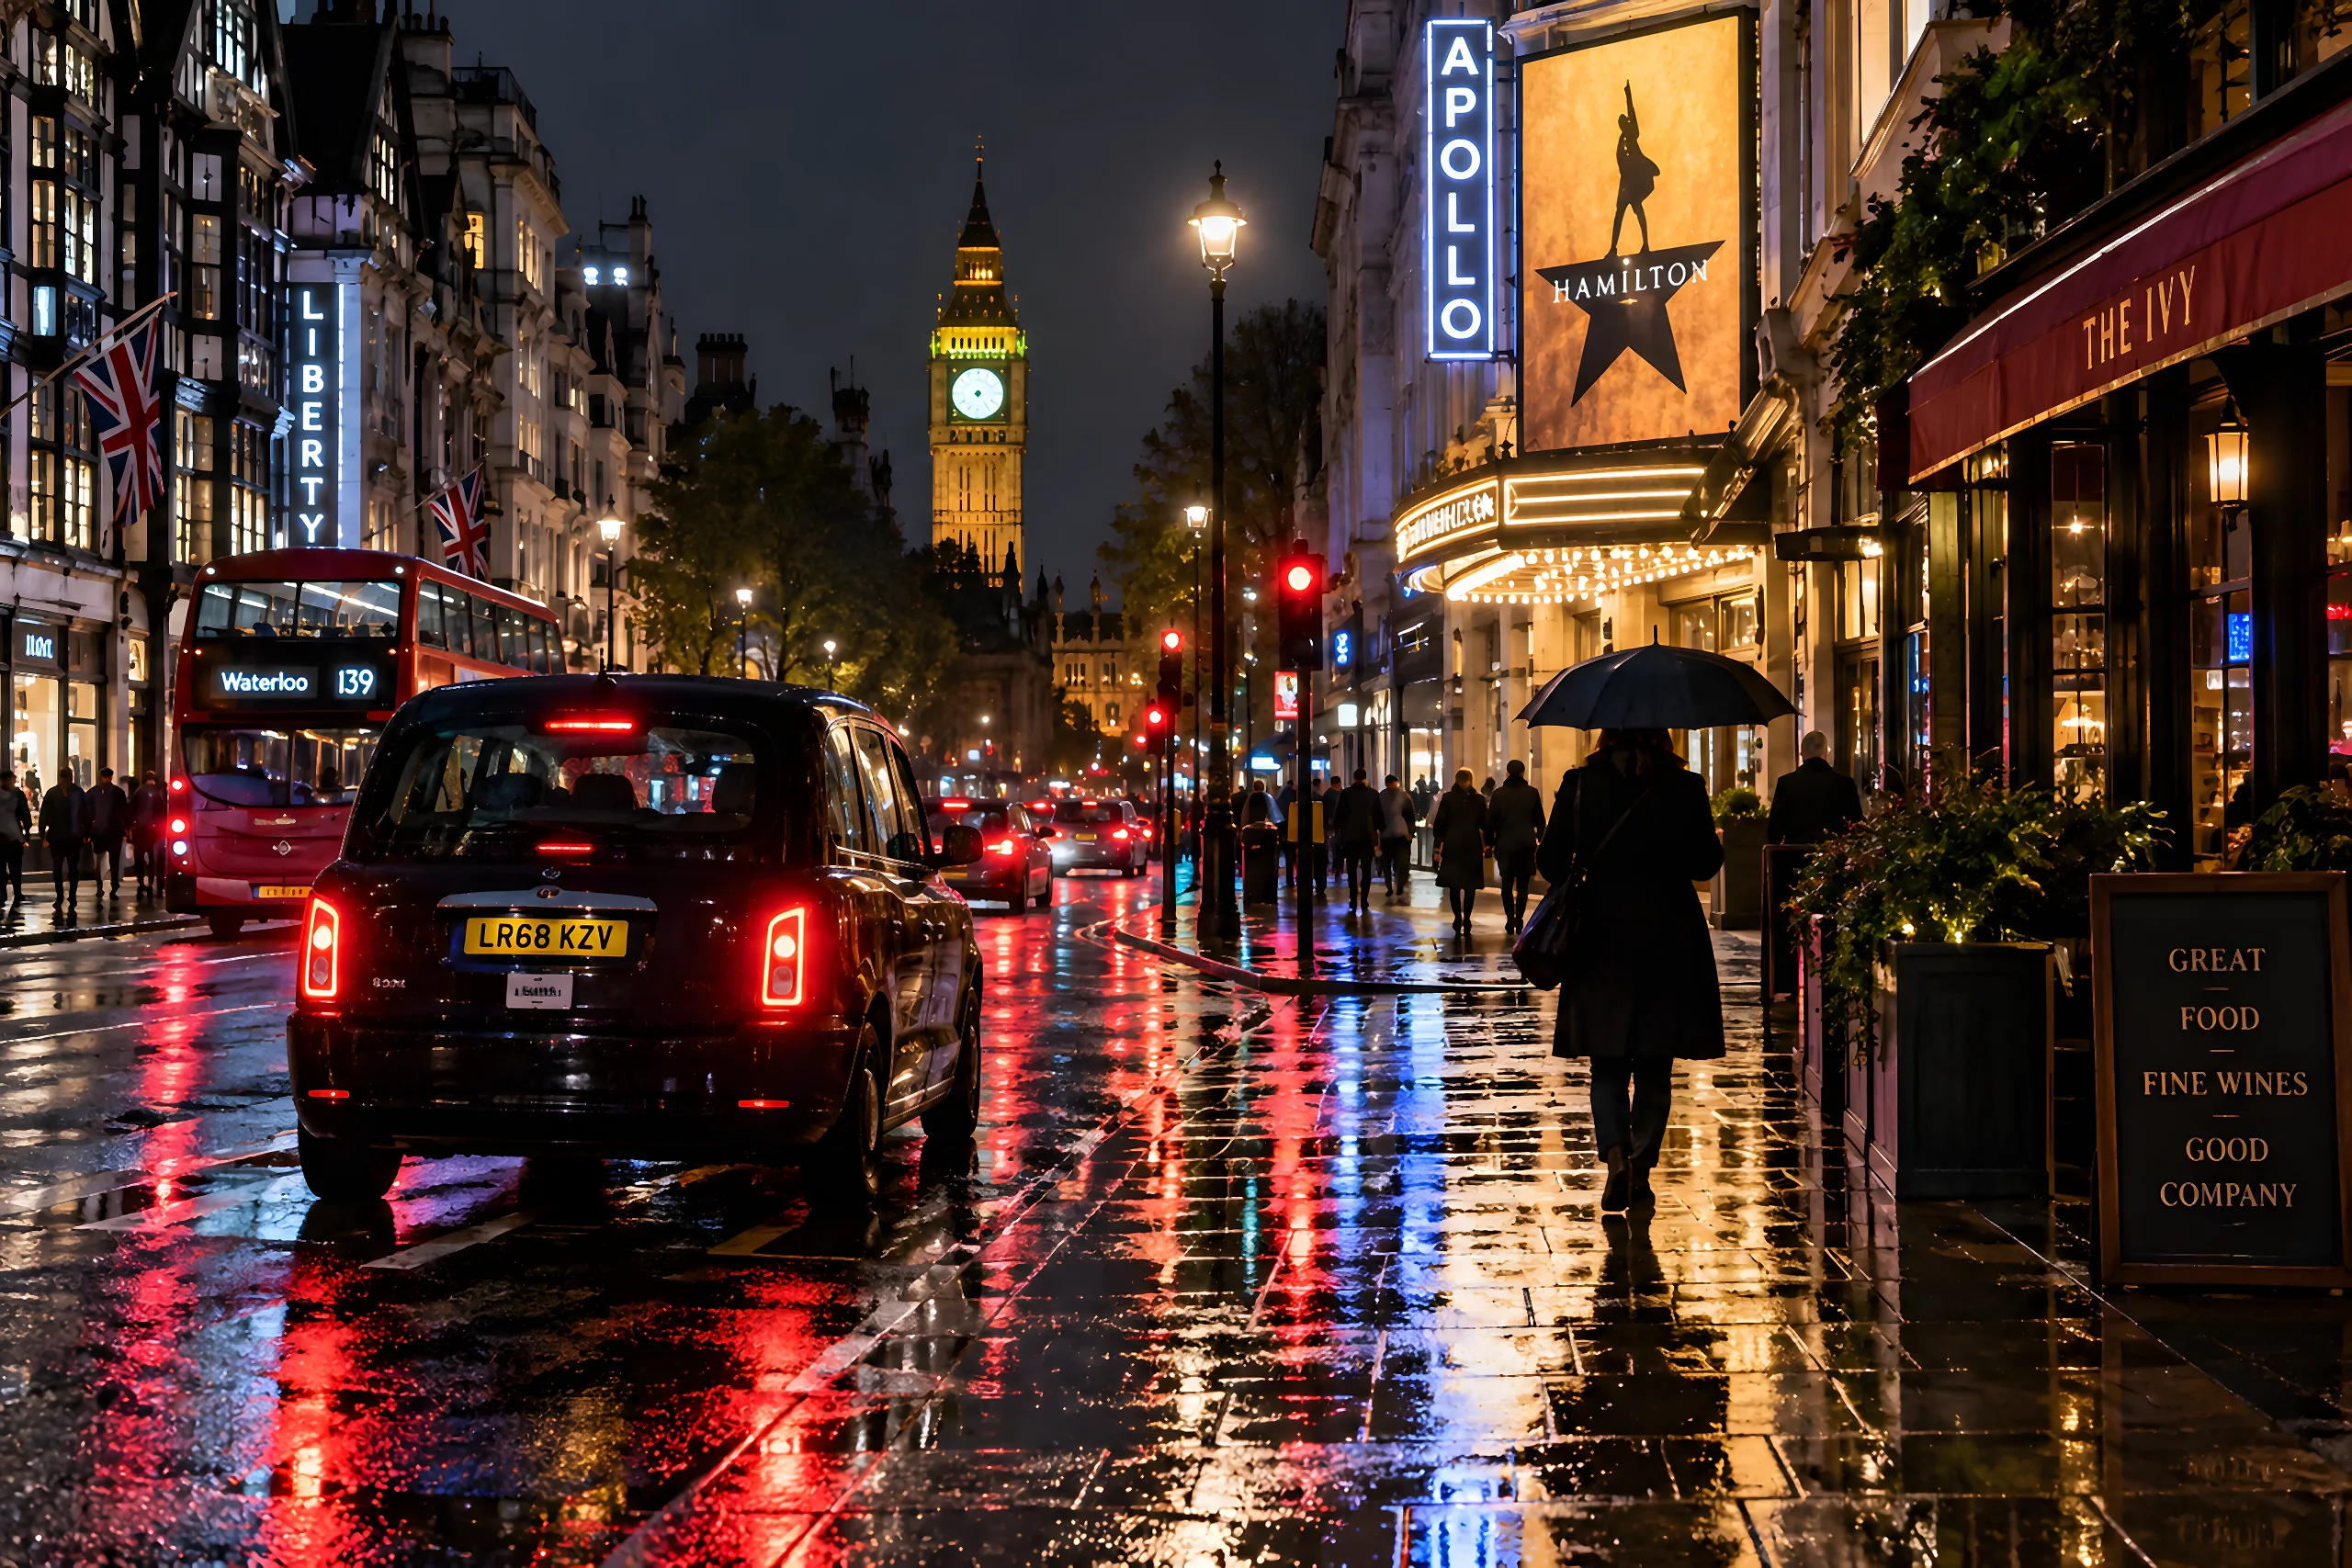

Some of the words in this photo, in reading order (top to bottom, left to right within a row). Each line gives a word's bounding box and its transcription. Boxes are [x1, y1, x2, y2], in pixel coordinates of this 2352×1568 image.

[1440, 36, 1481, 339] APOLLO
[1553, 259, 1708, 304] HAMILTON
[2083, 298, 2132, 370] THE
[2146, 265, 2195, 342] IVY
[299, 290, 324, 543] LIBERTY
[220, 671, 309, 692] Waterloo
[338, 669, 374, 695] 139
[479, 922, 551, 949] LR68
[559, 924, 614, 950] KZV
[2168, 947, 2266, 972] GREAT
[2180, 1006, 2260, 1031] FOOD
[2143, 1071, 2208, 1096] FINE
[2217, 1071, 2309, 1096] WINES
[2186, 1137, 2269, 1162] GOOD
[2160, 1181, 2297, 1208] COMPANY
